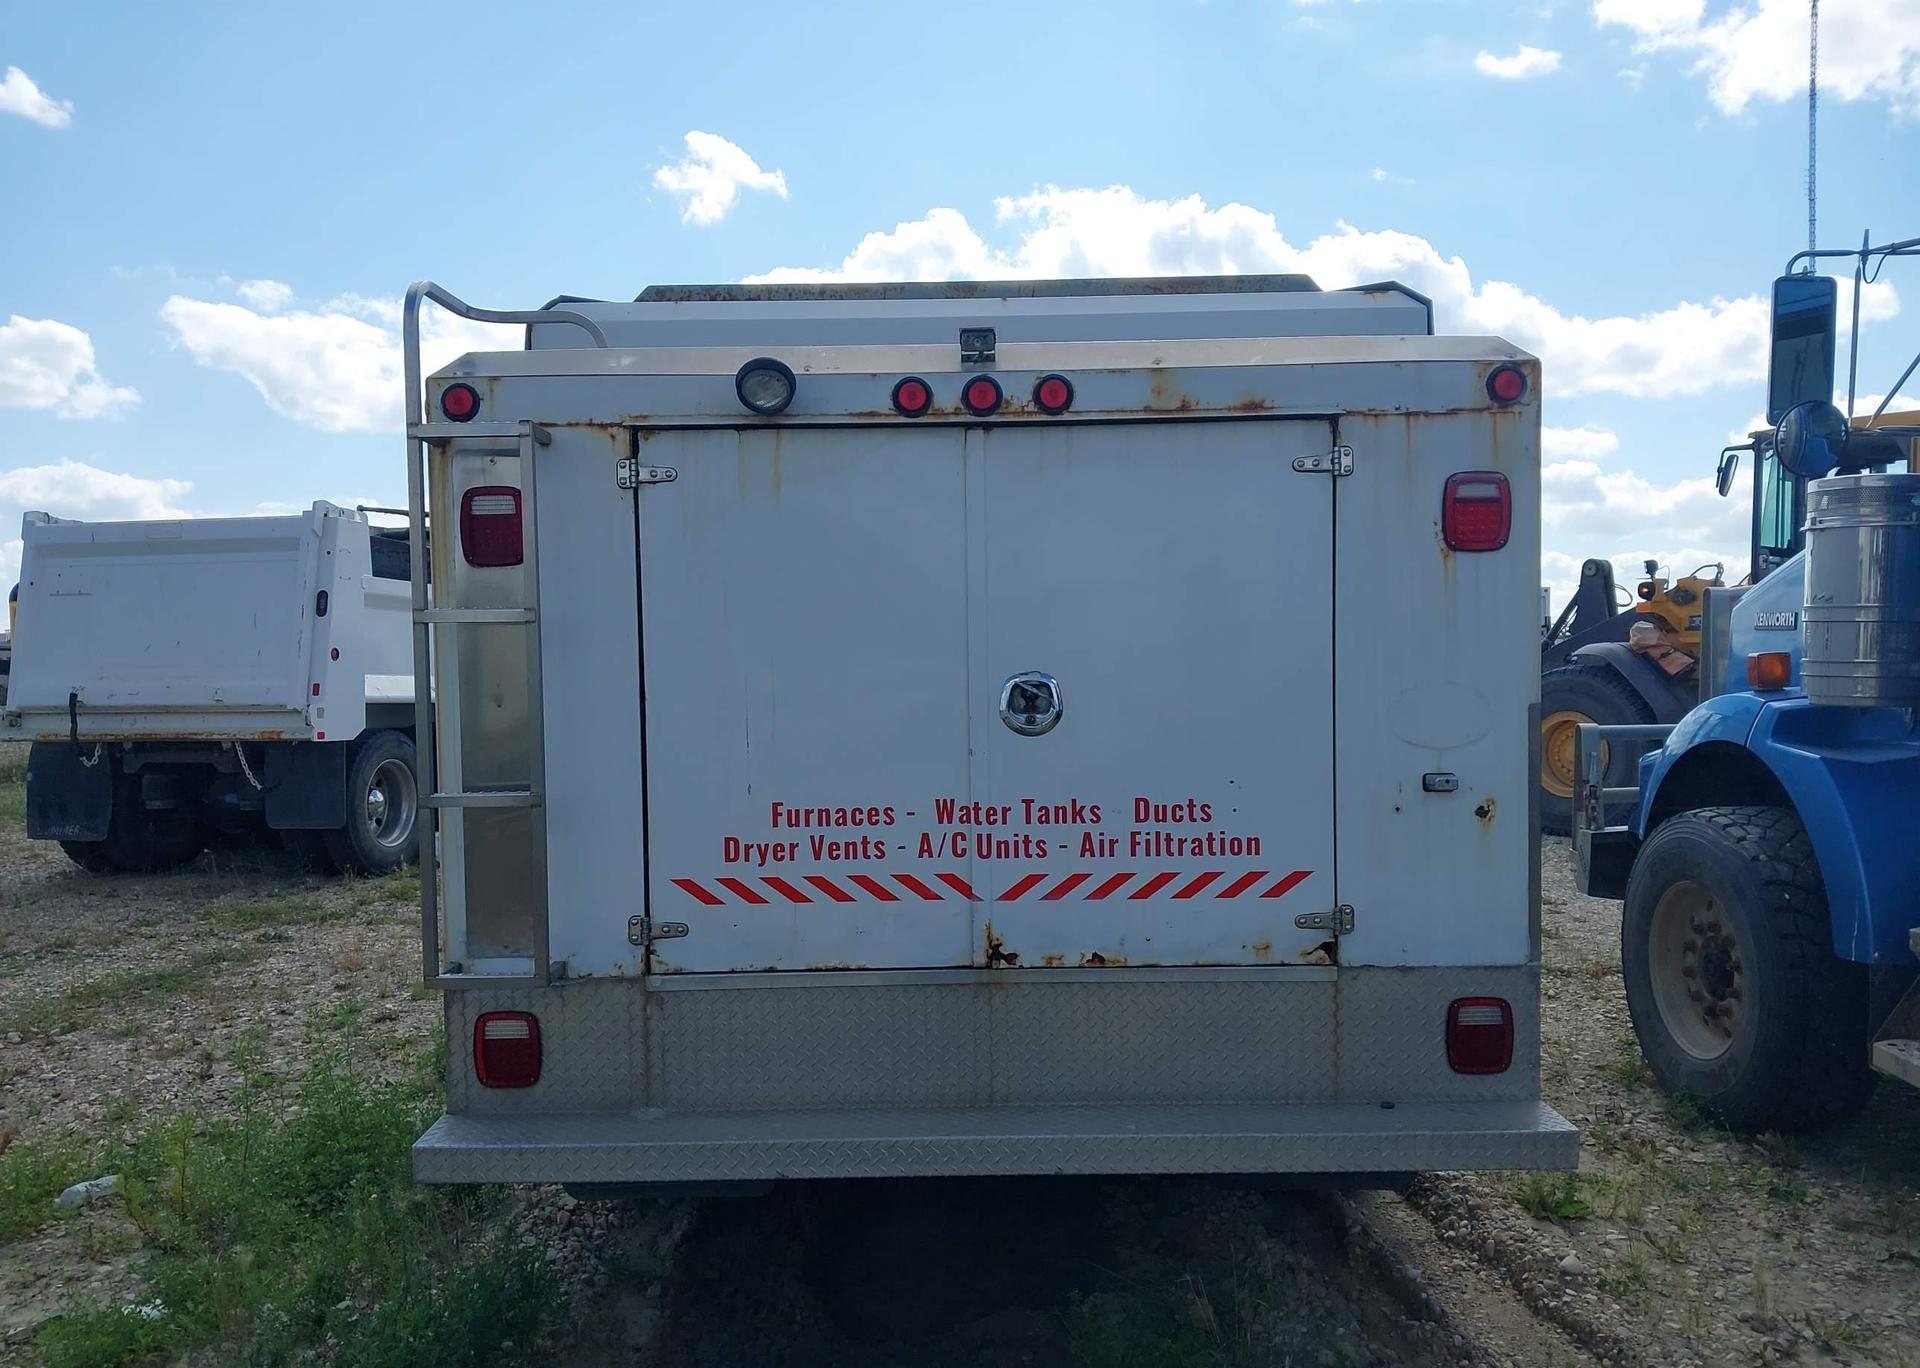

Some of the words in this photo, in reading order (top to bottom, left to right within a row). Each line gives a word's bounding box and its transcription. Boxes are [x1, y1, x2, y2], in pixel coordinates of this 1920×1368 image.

[1755, 612, 1795, 626] KENWORTH
[771, 801, 896, 828] Furnaces
[935, 798, 1011, 826] Water
[1021, 798, 1102, 825] Tanks
[1134, 797, 1214, 823] Ducts
[723, 836, 799, 867] Dryer
[810, 835, 887, 861] Vents
[917, 832, 969, 859] A/C
[976, 833, 1048, 859] Units
[1079, 832, 1119, 858] Air
[1129, 830, 1262, 857] Filtration
